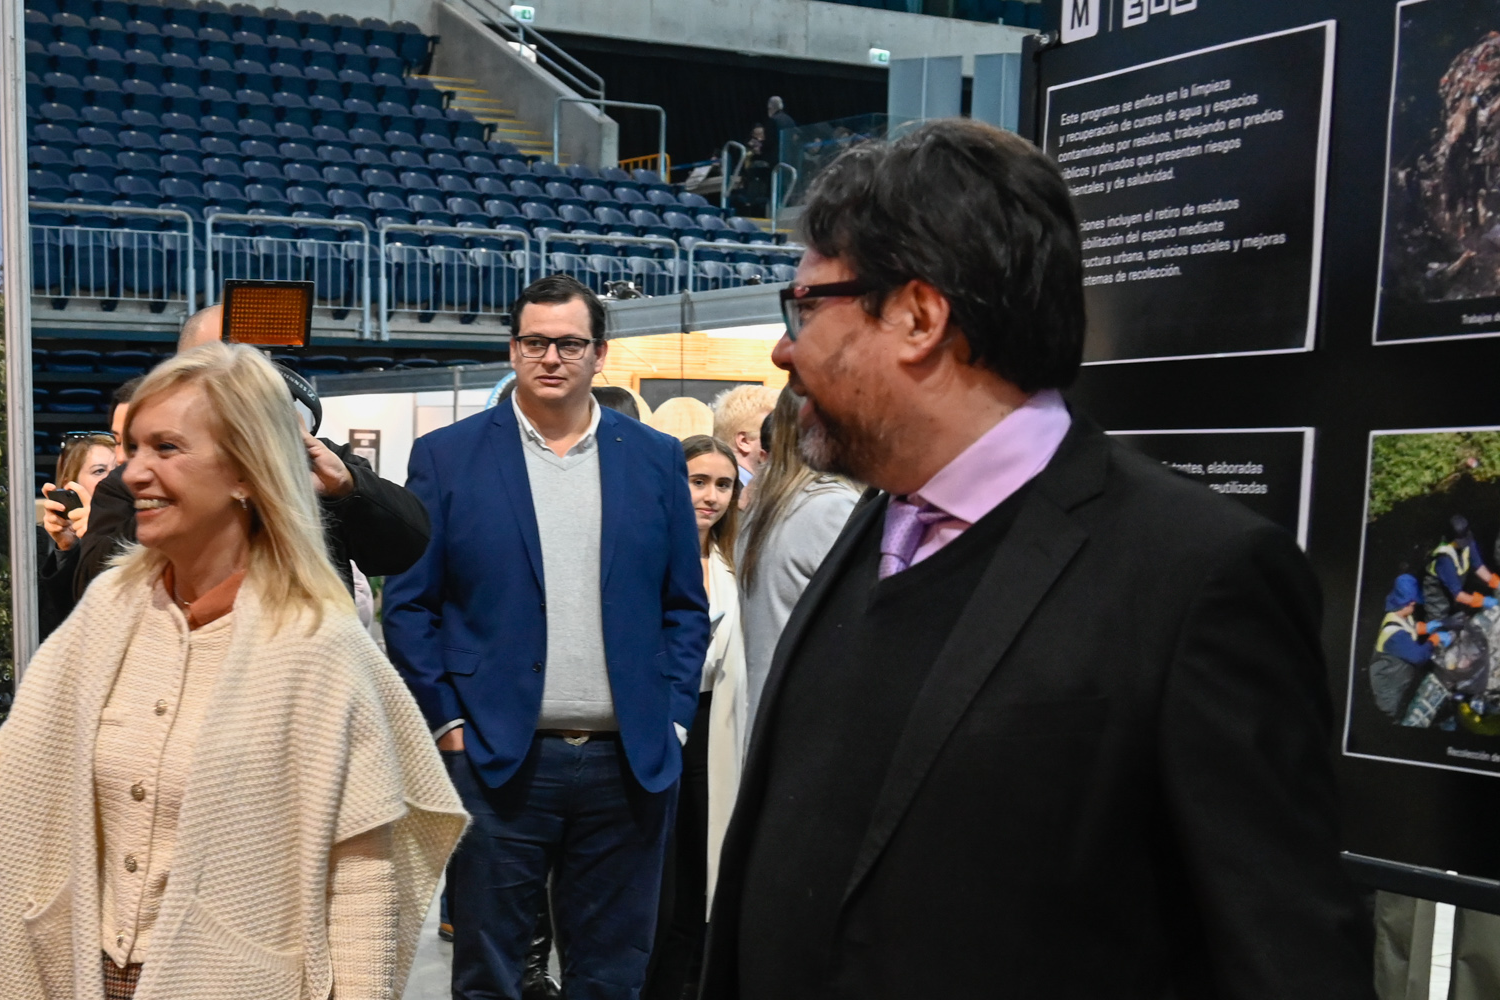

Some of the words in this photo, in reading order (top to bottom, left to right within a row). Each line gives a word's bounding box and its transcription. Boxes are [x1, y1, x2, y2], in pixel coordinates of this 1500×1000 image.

[1060, 114, 1079, 126] Este
[1081, 104, 1120, 123] programa
[1122, 102, 1132, 112] se
[1134, 93, 1163, 109] enfoca
[1166, 92, 1177, 102] en
[1180, 87, 1189, 99] la
[1191, 78, 1231, 97] limpieza
[1059, 135, 1065, 147] y
[1067, 122, 1118, 144] recuperación
[1120, 118, 1132, 130] de
[1133, 114, 1163, 128] cursos
[1165, 109, 1176, 122] de
[1179, 105, 1202, 122] agua
[1204, 105, 1210, 116] y
[1213, 92, 1258, 113] espacios
[1116, 139, 1131, 153] por
[1133, 131, 1172, 148] residuos,
[1174, 119, 1225, 140] trabajando
[1228, 117, 1241, 129] en
[1092, 165, 1097, 178] y
[1099, 157, 1135, 176] privados
[1137, 154, 1153, 170] que
[1155, 144, 1203, 165] presenten
[1204, 137, 1241, 155] riesgos
[1105, 180, 1112, 194] y
[1114, 177, 1124, 190] de
[1107, 211, 1142, 229] incluyen
[1144, 208, 1152, 222] el
[1155, 205, 1179, 220] retiro
[1182, 203, 1194, 217] de
[1197, 198, 1240, 215] residuos
[1126, 230, 1139, 243] del
[1142, 225, 1176, 242] espacio
[1179, 220, 1224, 236] mediante
[1113, 248, 1145, 265] urbana,
[1147, 243, 1188, 260] servicios
[1190, 238, 1230, 254] sociales
[1233, 240, 1240, 253] y
[1243, 232, 1286, 250] mejoras
[1116, 269, 1126, 283] de
[1128, 263, 1182, 281] recolección.
